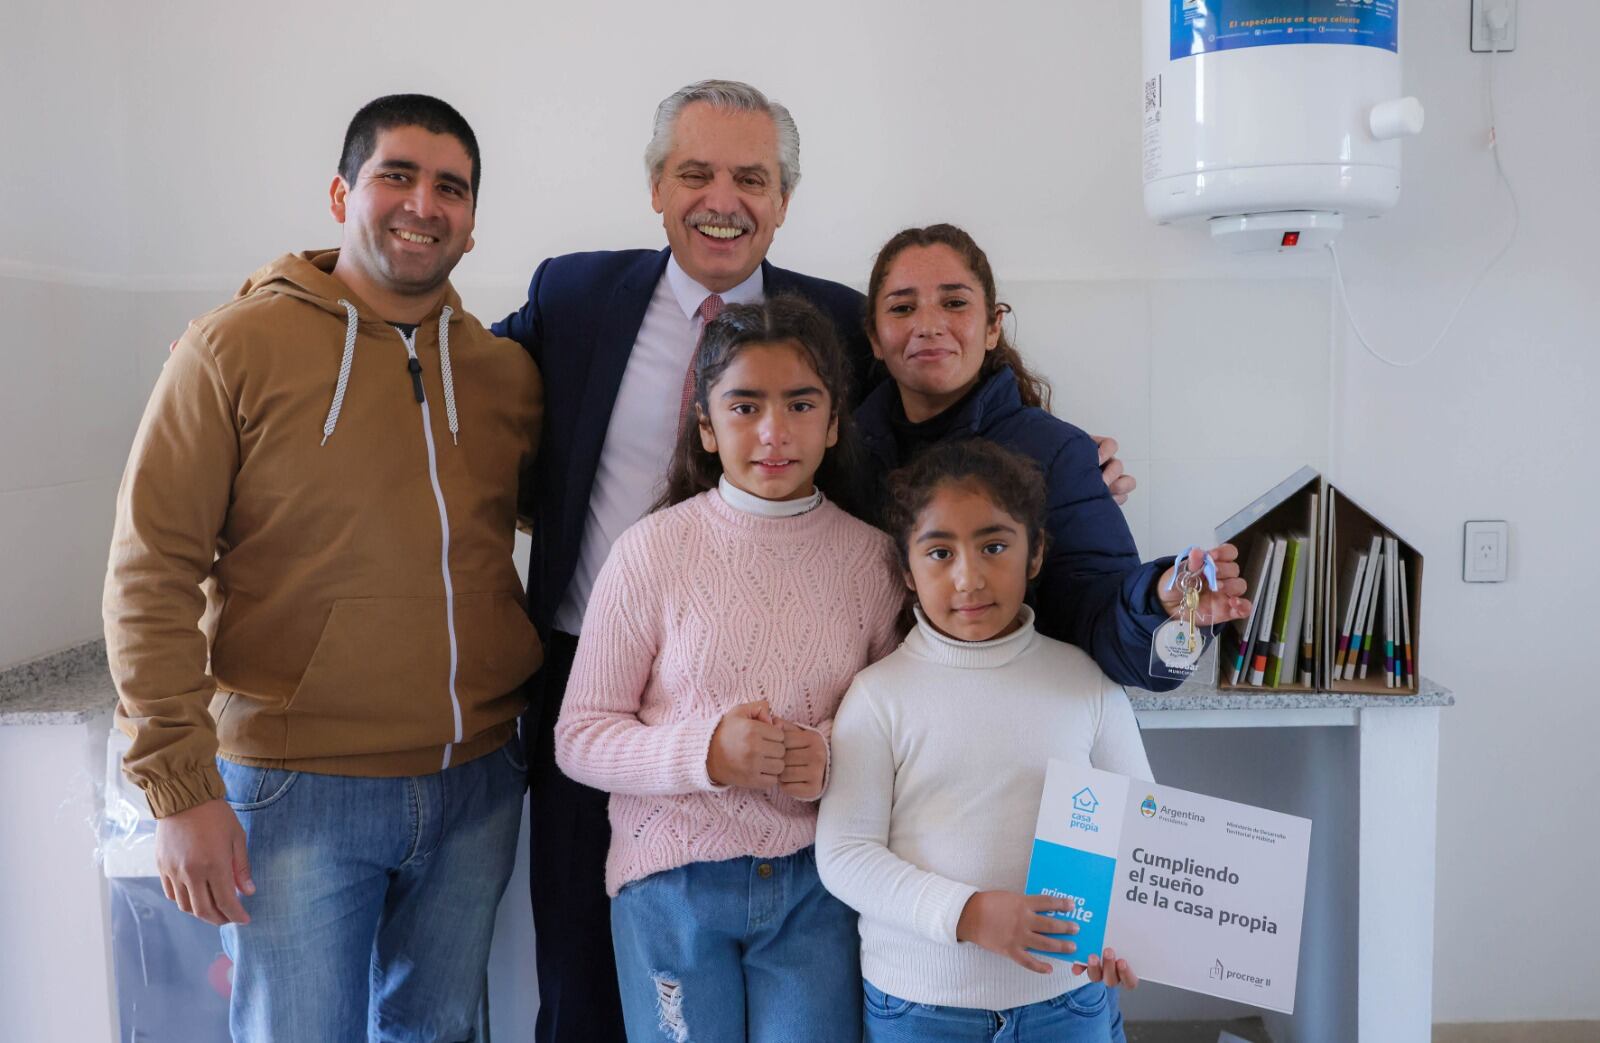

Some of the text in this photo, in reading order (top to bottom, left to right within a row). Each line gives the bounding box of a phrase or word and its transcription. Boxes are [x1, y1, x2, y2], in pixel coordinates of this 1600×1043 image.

[1240, 16, 1292, 28] especialista
[1307, 16, 1328, 25] agua
[1330, 15, 1361, 24] caliente
[1071, 812, 1092, 823] casa
[1160, 805, 1206, 823] Argentina
[1070, 819, 1099, 833] propia
[1131, 847, 1240, 885] Cumpliendo
[1128, 867, 1204, 897] el sueño
[1125, 885, 1278, 934] de la casa propia
[1226, 969, 1264, 986] procrear
